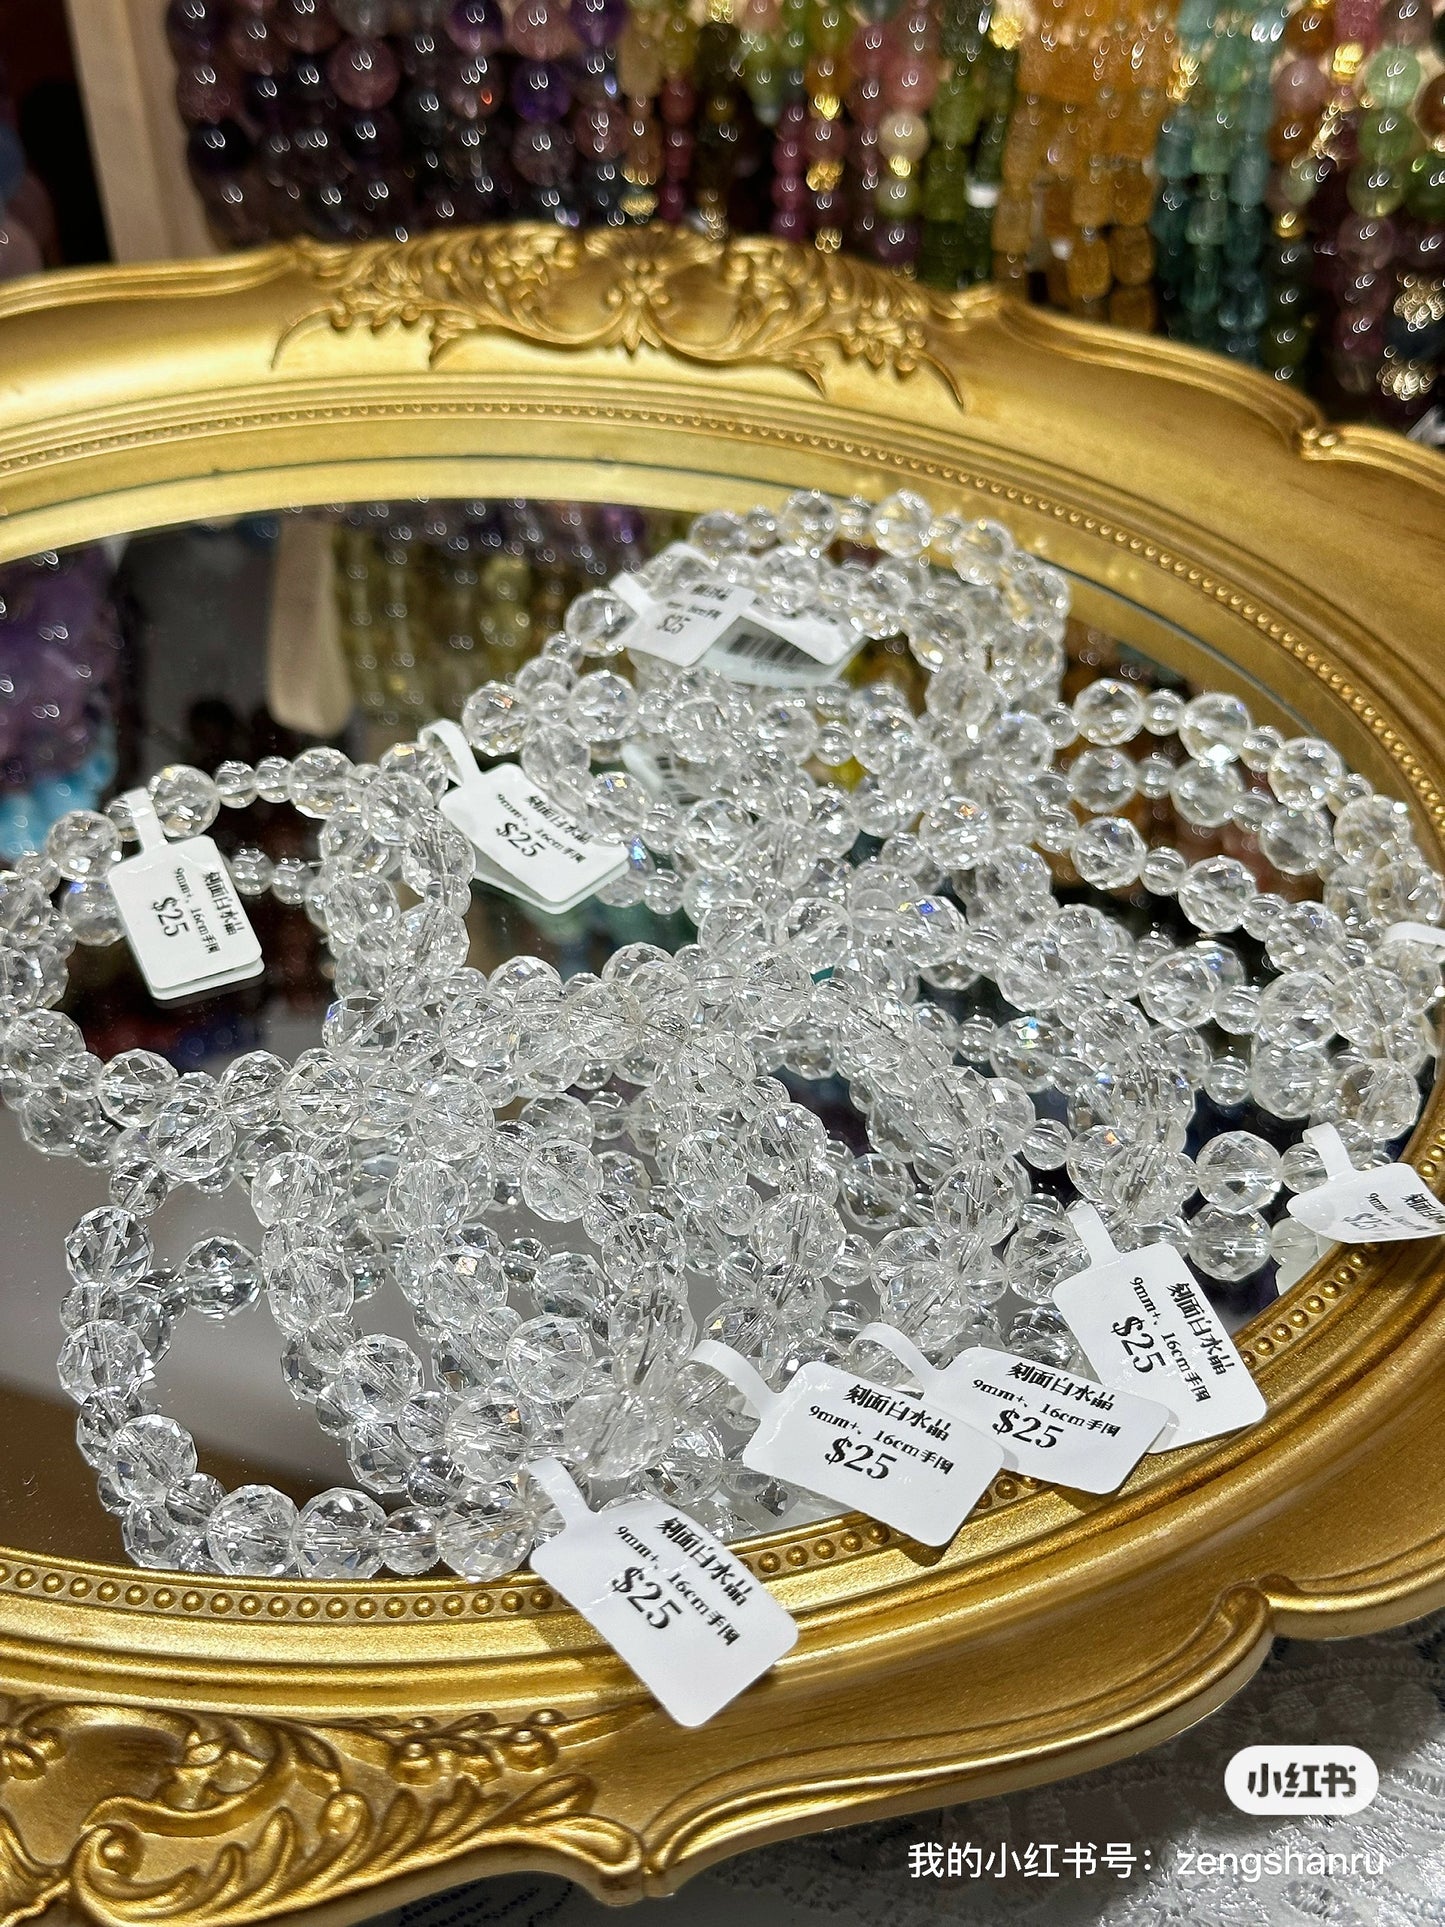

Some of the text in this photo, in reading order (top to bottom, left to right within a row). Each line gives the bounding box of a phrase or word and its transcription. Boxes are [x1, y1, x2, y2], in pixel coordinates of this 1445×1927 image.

[495, 822, 547, 857] $25
[151, 896, 190, 937] $25
[203, 871, 245, 936] 刻面白水晶
[1110, 1315, 1166, 1374] $25
[1167, 1282, 1236, 1376] 刻面白水晶
[843, 1383, 952, 1442] 刻面白水晶
[1007, 1362, 1117, 1412] 刻面白水晶
[824, 1436, 897, 1480] $25
[992, 1408, 1064, 1449] $25
[653, 1517, 754, 1607] 刻面白水晶
[611, 1566, 683, 1630] $25
